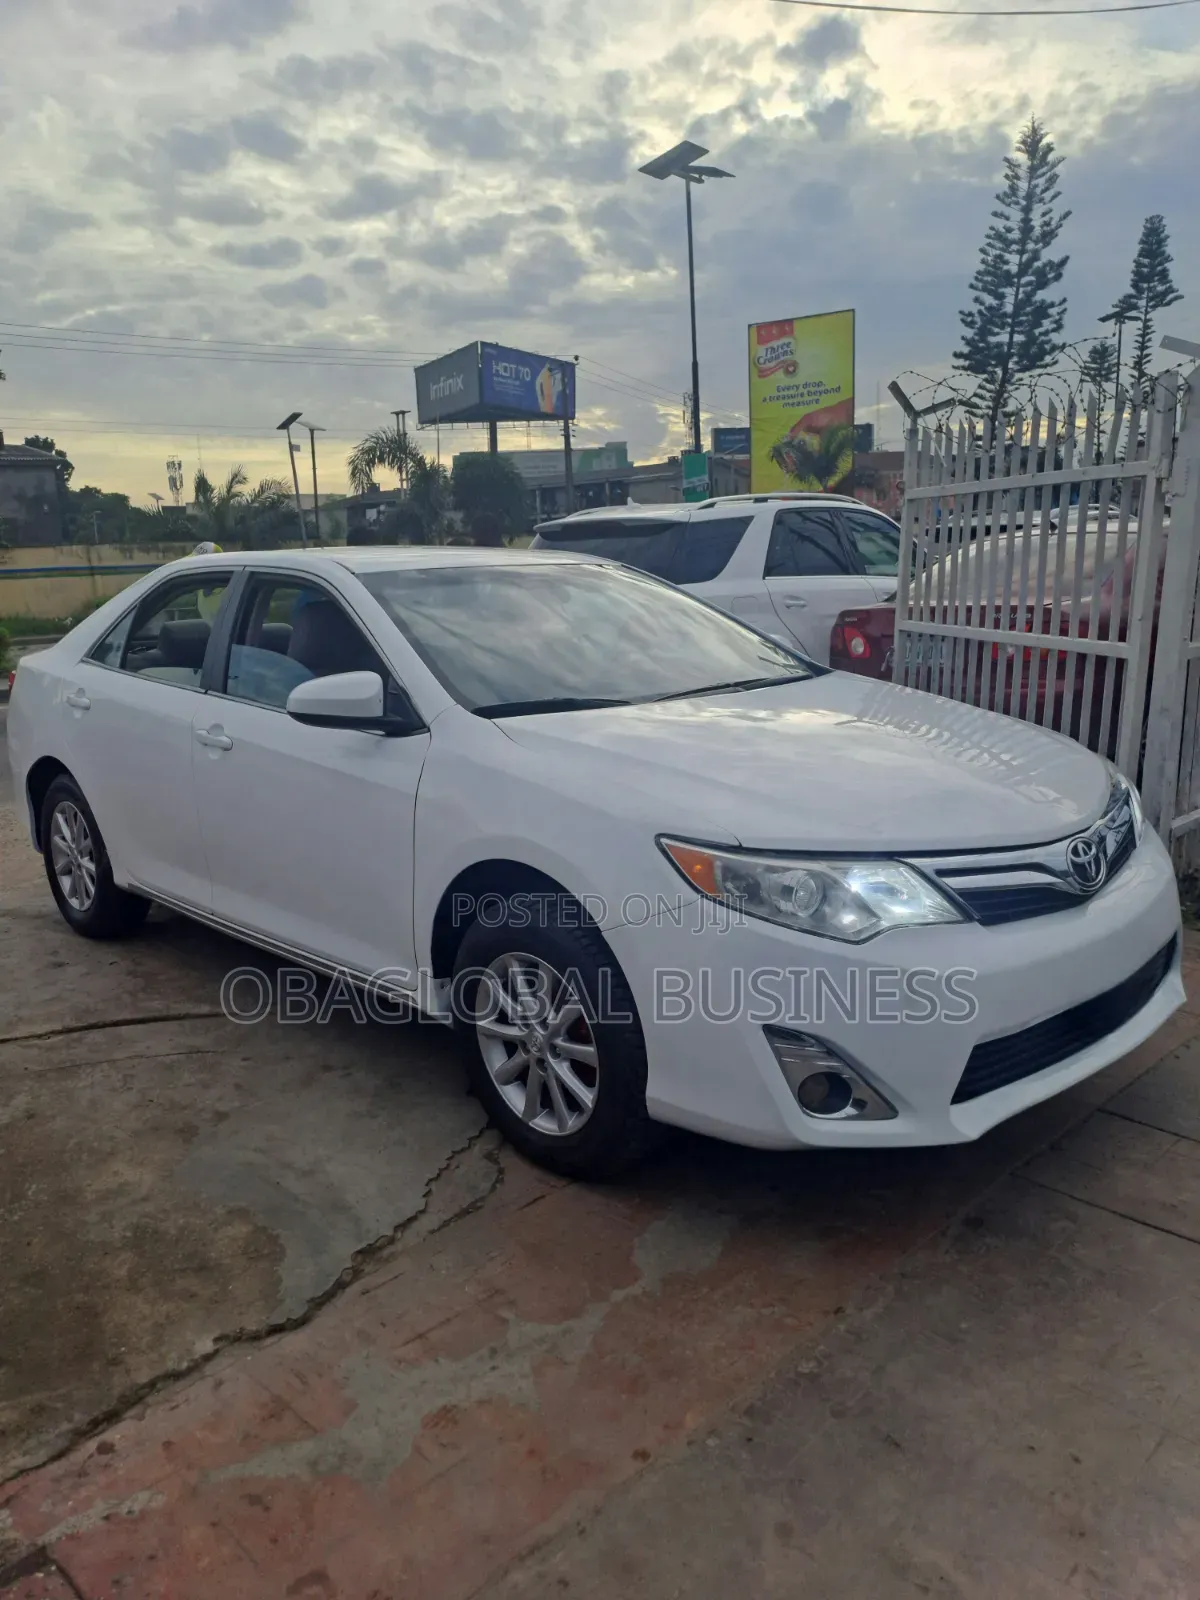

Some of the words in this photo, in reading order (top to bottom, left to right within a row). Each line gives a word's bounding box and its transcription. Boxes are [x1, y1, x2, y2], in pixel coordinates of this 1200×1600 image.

[757, 349, 794, 365] Crowns
[764, 341, 792, 357] Three
[430, 371, 464, 400] Infinix
[768, 391, 805, 402] treasure
[807, 385, 841, 398] beyond
[776, 383, 800, 393] Every
[782, 398, 820, 408] measure
